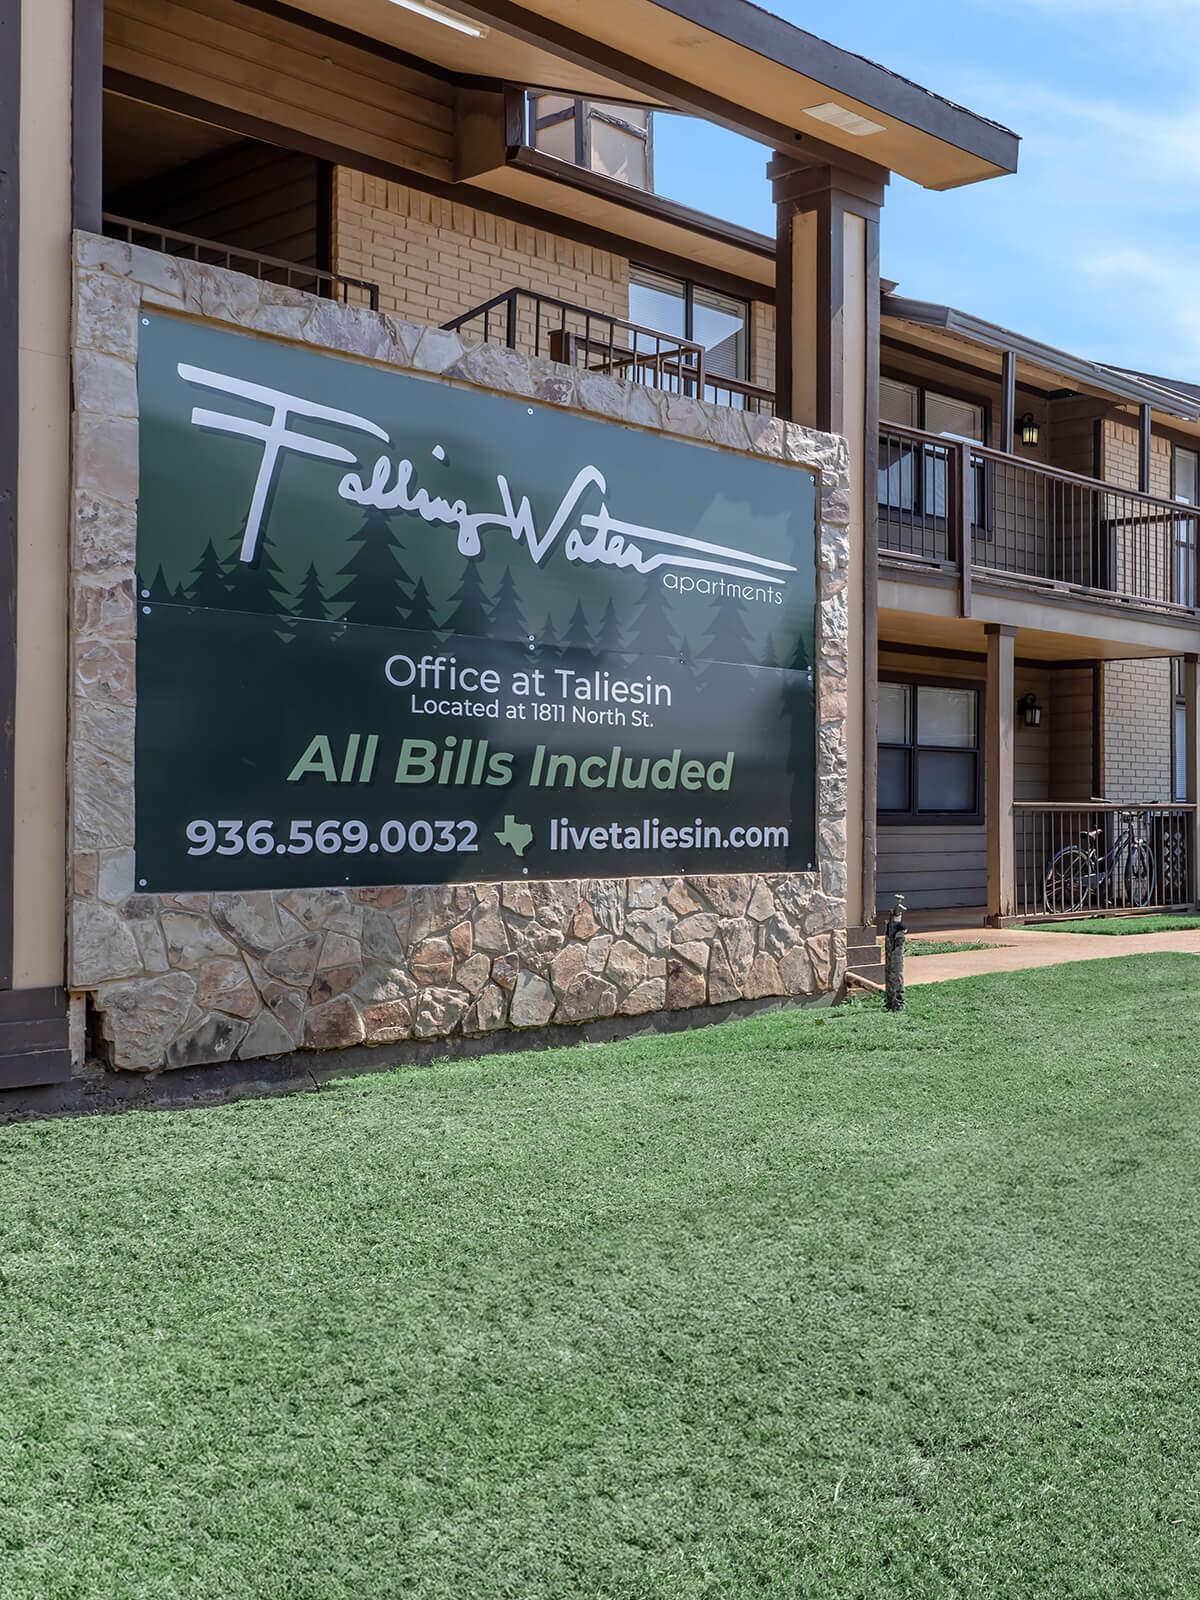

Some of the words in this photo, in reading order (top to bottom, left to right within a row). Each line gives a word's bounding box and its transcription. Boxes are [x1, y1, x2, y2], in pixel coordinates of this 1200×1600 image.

[177, 362, 483, 563] Falling
[497, 464, 798, 584] Water
[662, 572, 784, 605] apartments
[384, 655, 501, 694] Office
[511, 668, 545, 697] at
[552, 669, 673, 707] Taliesin
[411, 694, 499, 720] Located
[505, 702, 527, 721] at
[531, 702, 566, 724] 1811
[572, 706, 626, 727] North
[630, 709, 655, 729] St.
[286, 734, 380, 784] All
[394, 735, 515, 787] Bills
[529, 744, 736, 792] Included
[185, 819, 480, 857] 936.569.0032
[549, 816, 790, 851] livetaliesin.com
